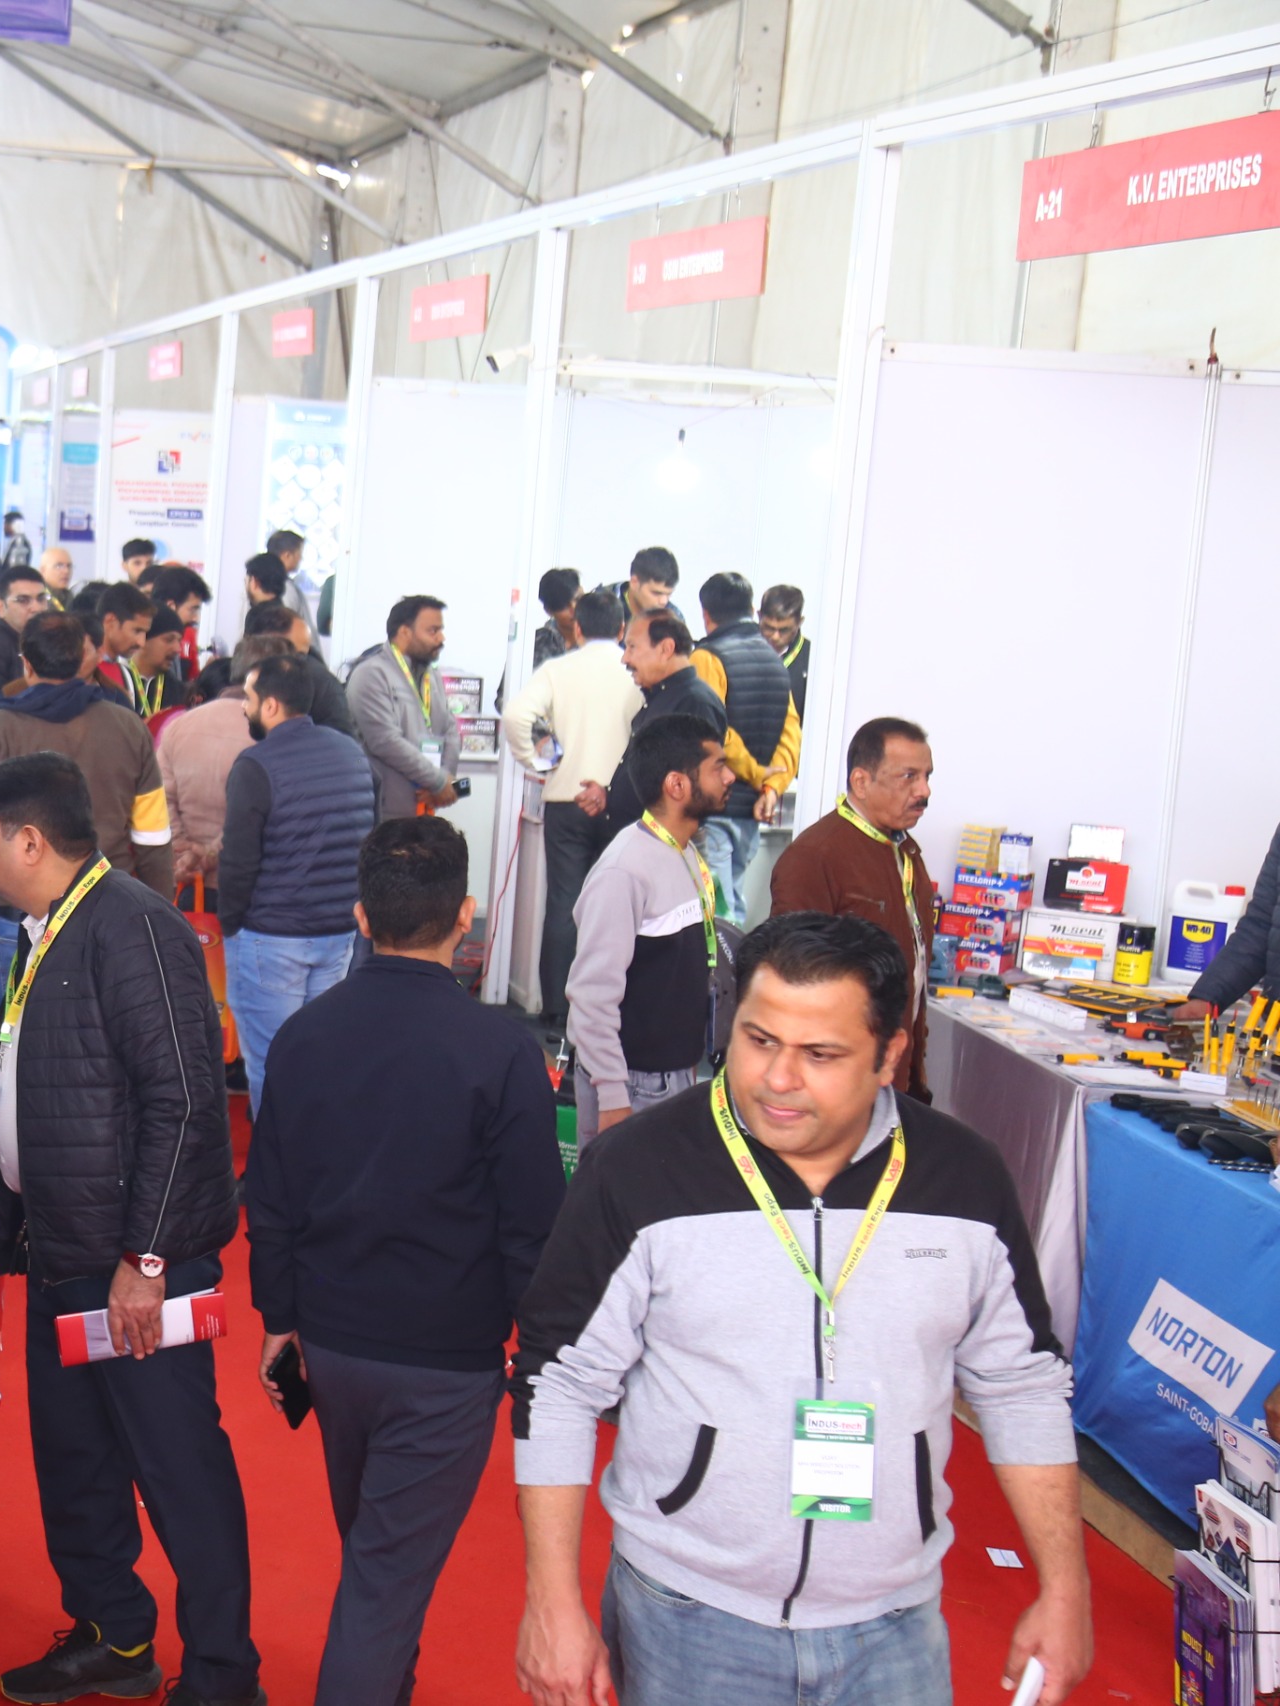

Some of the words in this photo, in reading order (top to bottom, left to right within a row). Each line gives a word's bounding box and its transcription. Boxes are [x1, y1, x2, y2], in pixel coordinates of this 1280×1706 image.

[1035, 188, 1063, 222] A-21
[1127, 173, 1154, 205] K.V.
[1157, 153, 1262, 200] ENTERPRISES
[1186, 923, 1212, 935] WD-40
[737, 1155, 755, 1183] VAS
[885, 1158, 903, 1183] VAS
[764, 1193, 778, 1217] Expo
[871, 1199, 886, 1223] Expo
[1146, 1306, 1243, 1389] NORTON
[819, 1502, 852, 1514] VISITOR
